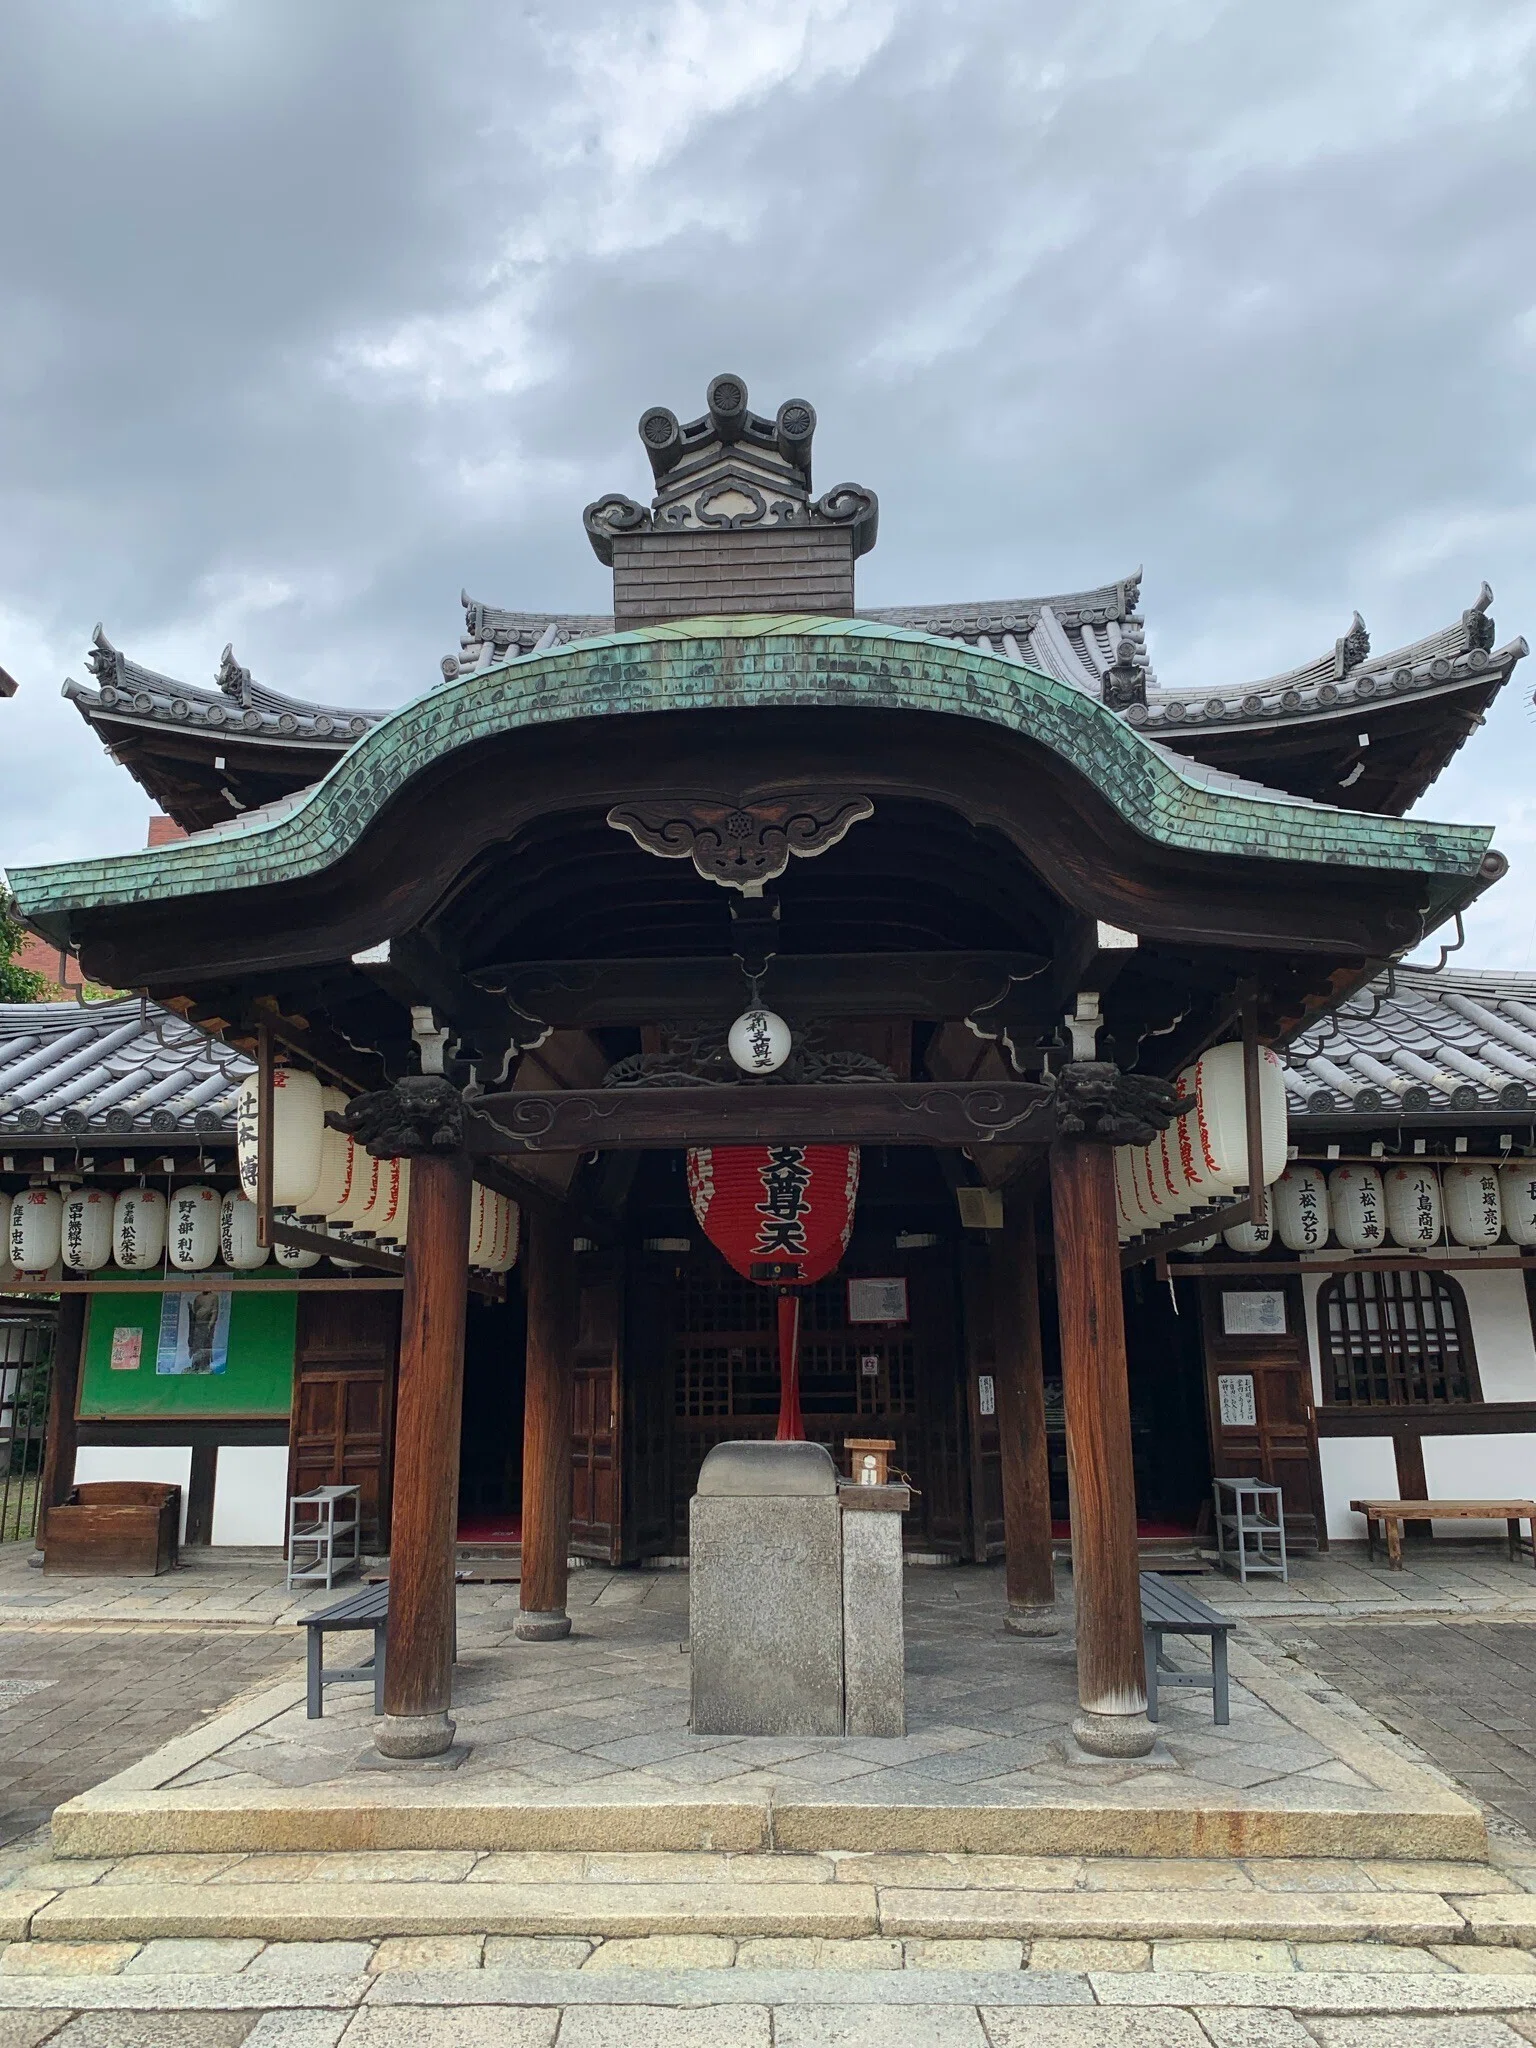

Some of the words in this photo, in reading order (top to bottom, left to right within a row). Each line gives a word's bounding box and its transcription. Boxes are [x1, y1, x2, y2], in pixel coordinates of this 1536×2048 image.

[744, 1010, 775, 1068] 摩利支尊天
[177, 1200, 197, 1263] 野々部利弘
[1359, 1177, 1380, 1240] 上松正典
[1413, 1179, 1434, 1240] 小島商店
